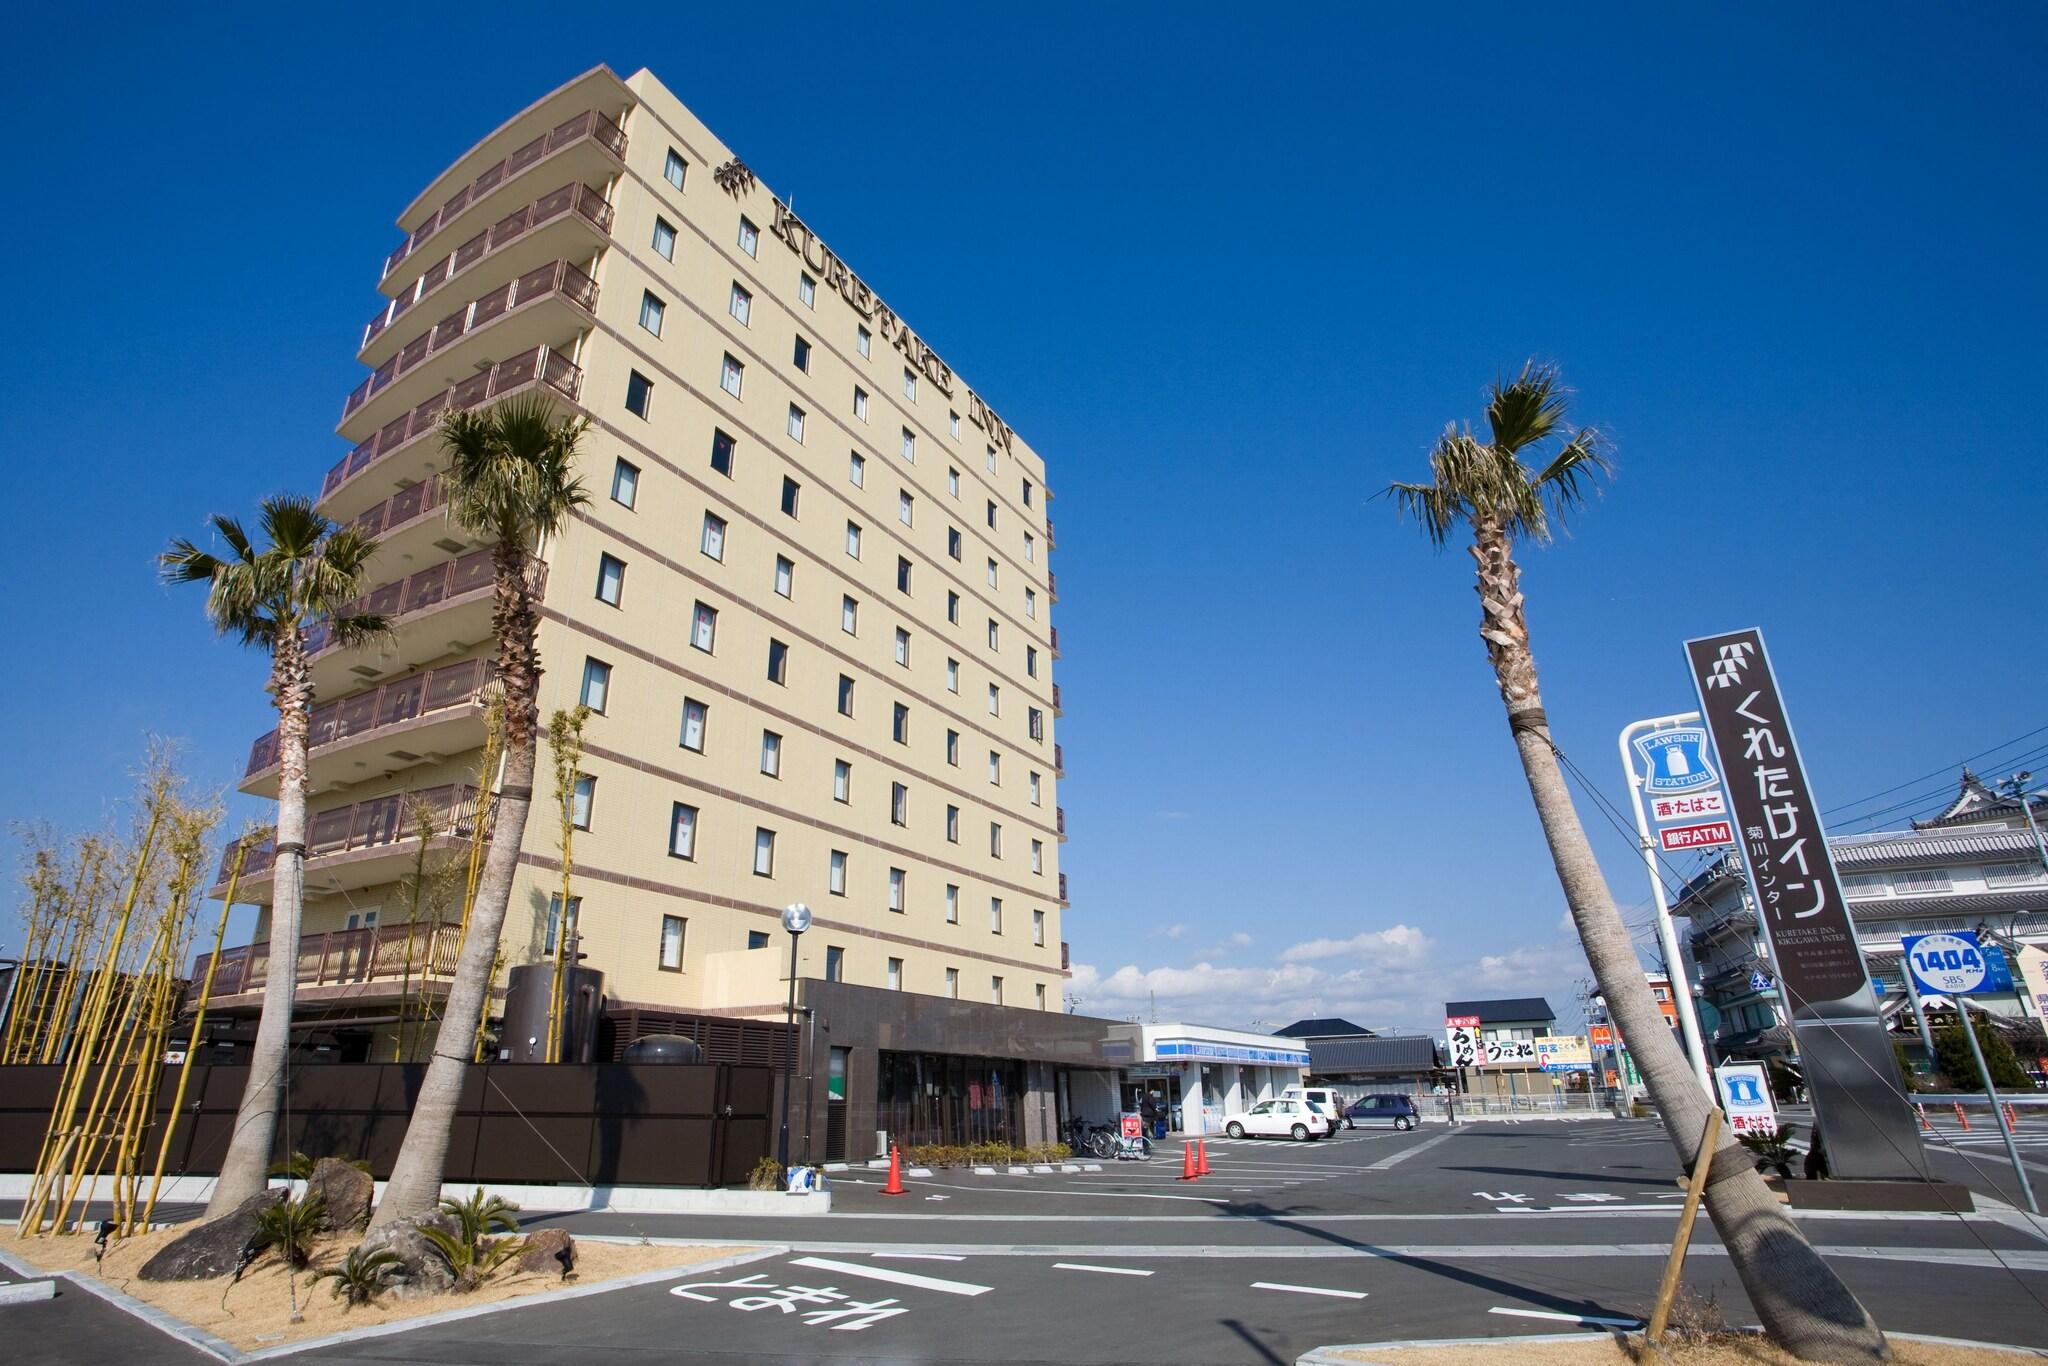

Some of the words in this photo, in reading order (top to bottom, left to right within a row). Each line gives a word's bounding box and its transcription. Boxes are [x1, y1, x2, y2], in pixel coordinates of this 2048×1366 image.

[770, 196, 954, 400] KURETAKE
[968, 390, 1014, 458] INN
[1645, 734, 1699, 750] LAWSON
[1655, 771, 1709, 787] STATION
[1735, 690, 1825, 919] くれたけイン
[1666, 827, 1727, 846] 銀行ATM
[1746, 826, 1782, 921] 菊川インター
[1775, 927, 1818, 938] KURETAKE
[1820, 926, 1836, 934] INN
[1777, 936, 1820, 946] KIKUGAWA
[1822, 933, 1846, 942] INTER
[1913, 948, 1981, 972] 1404
[1942, 975, 1964, 985] SBS
[669, 1274, 911, 1331] とまれ
